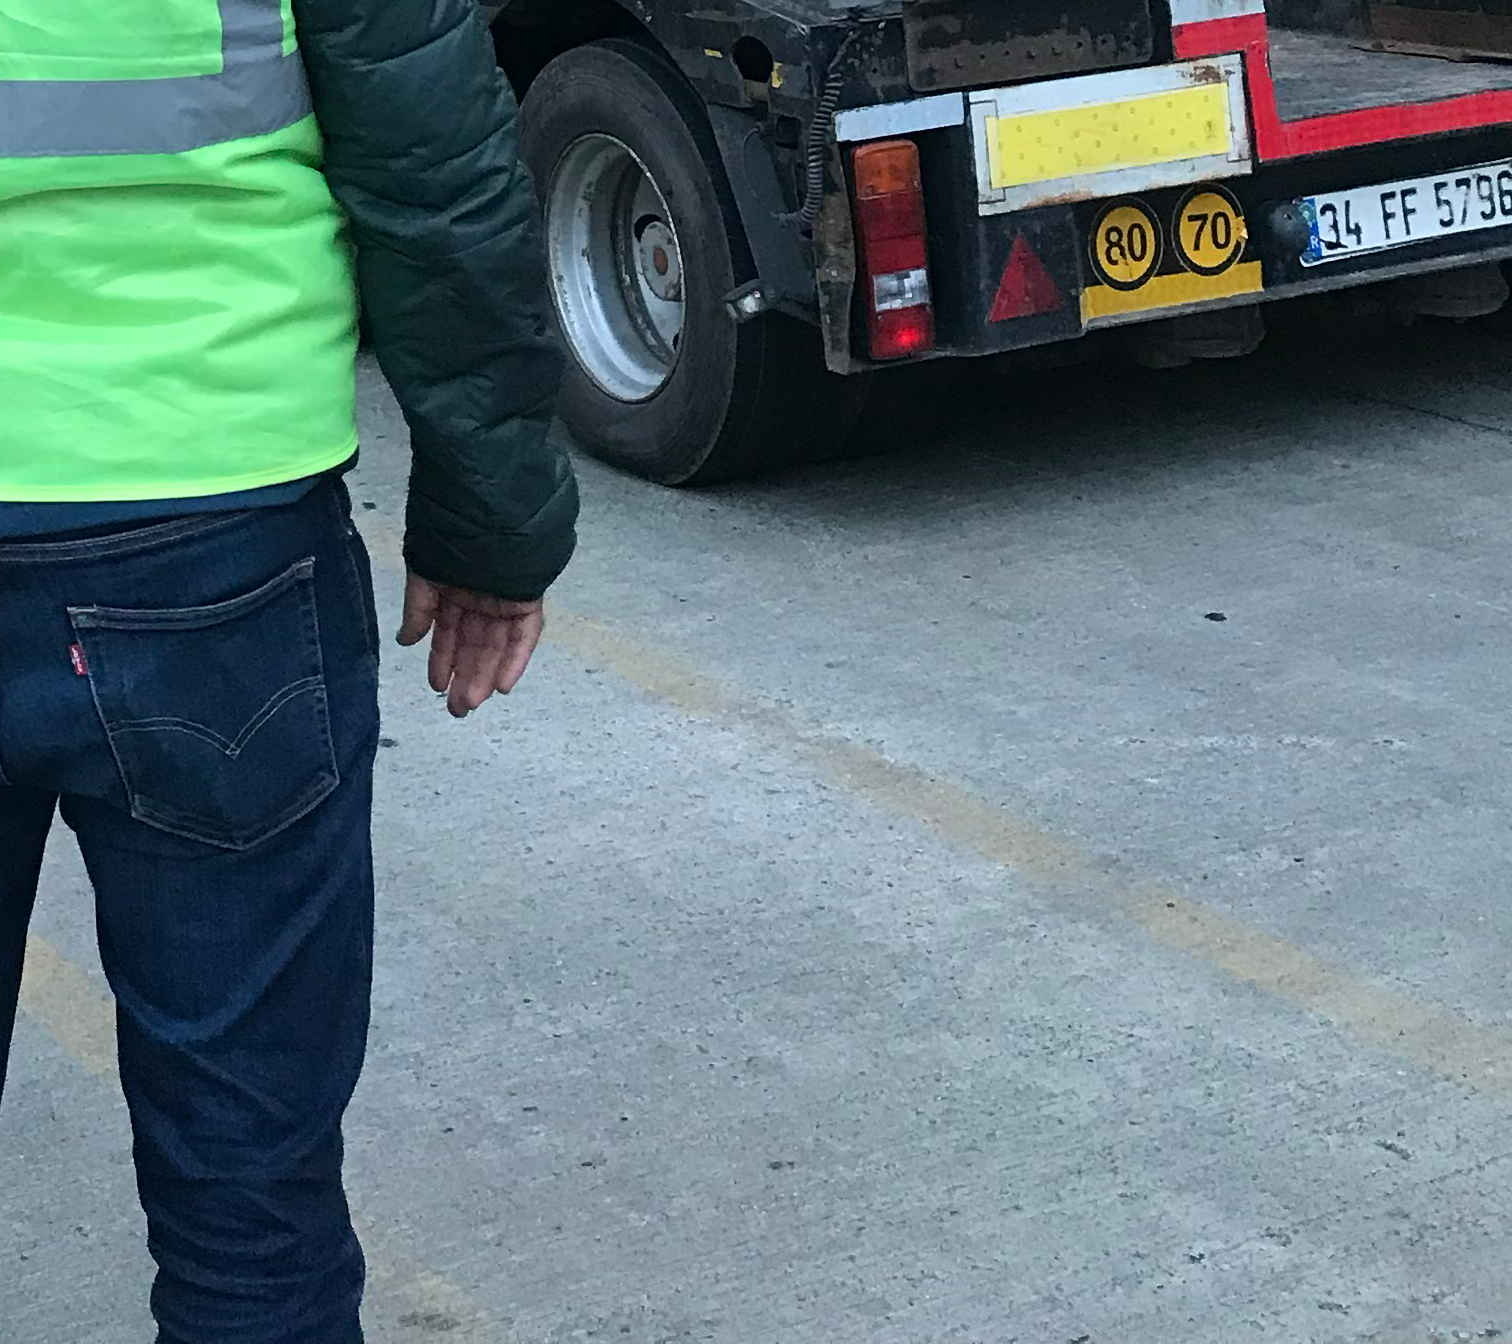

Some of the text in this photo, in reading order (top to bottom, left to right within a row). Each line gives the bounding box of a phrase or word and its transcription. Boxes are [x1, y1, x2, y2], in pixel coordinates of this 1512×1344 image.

[1380, 187, 1418, 239] FF
[1434, 169, 1512, 228] 5796
[1104, 222, 1148, 266] 80
[1187, 211, 1232, 252] 70
